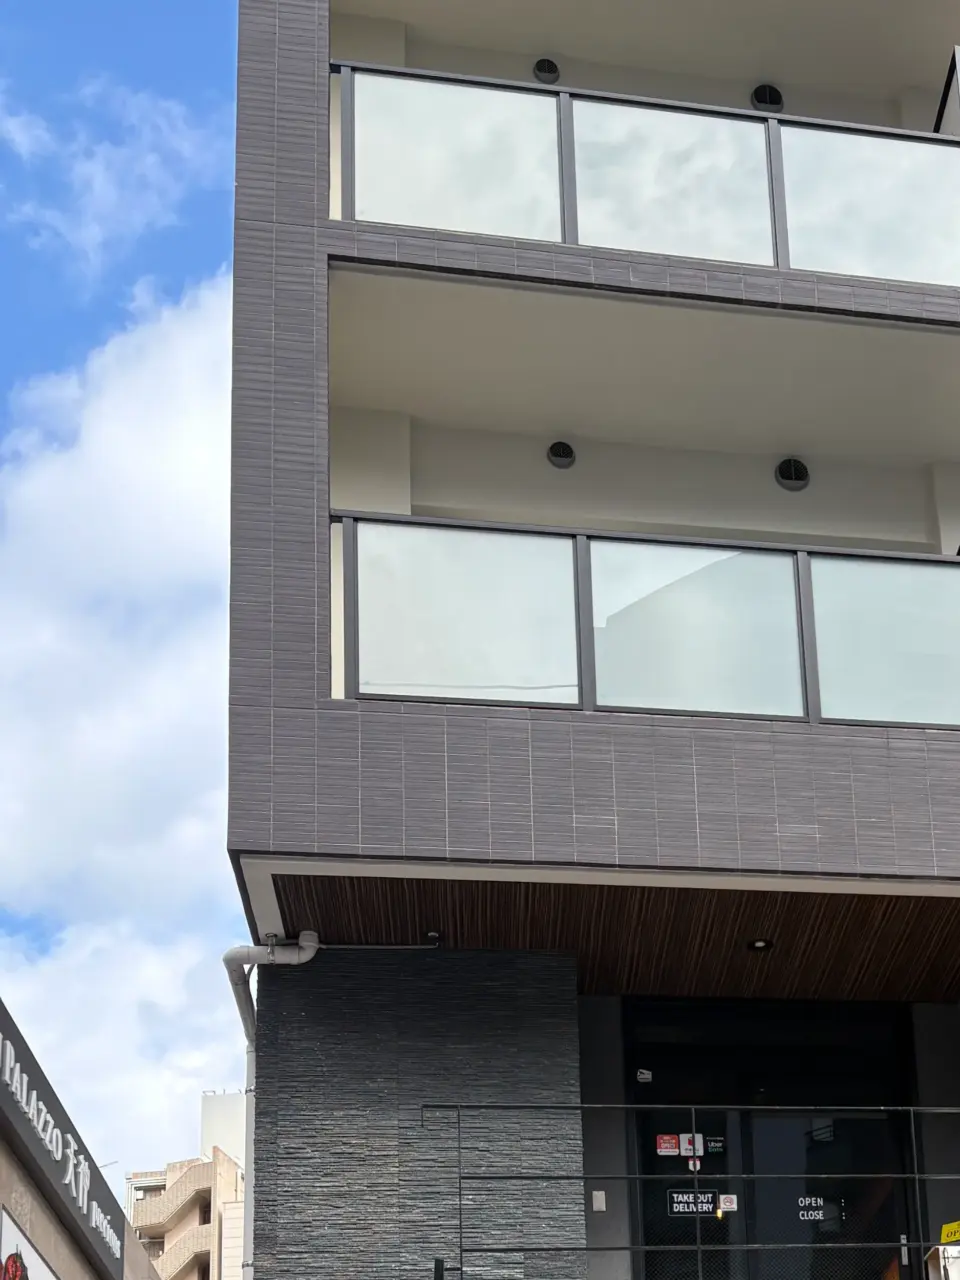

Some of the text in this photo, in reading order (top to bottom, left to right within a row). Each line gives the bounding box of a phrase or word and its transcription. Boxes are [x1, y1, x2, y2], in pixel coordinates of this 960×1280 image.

[4, 1040, 62, 1161] PALAZZO
[672, 1193, 695, 1203] TAKE
[798, 1197, 824, 1207] OPEN
[673, 1203, 714, 1212] DELIVERY
[799, 1210, 824, 1220] CLOSE
